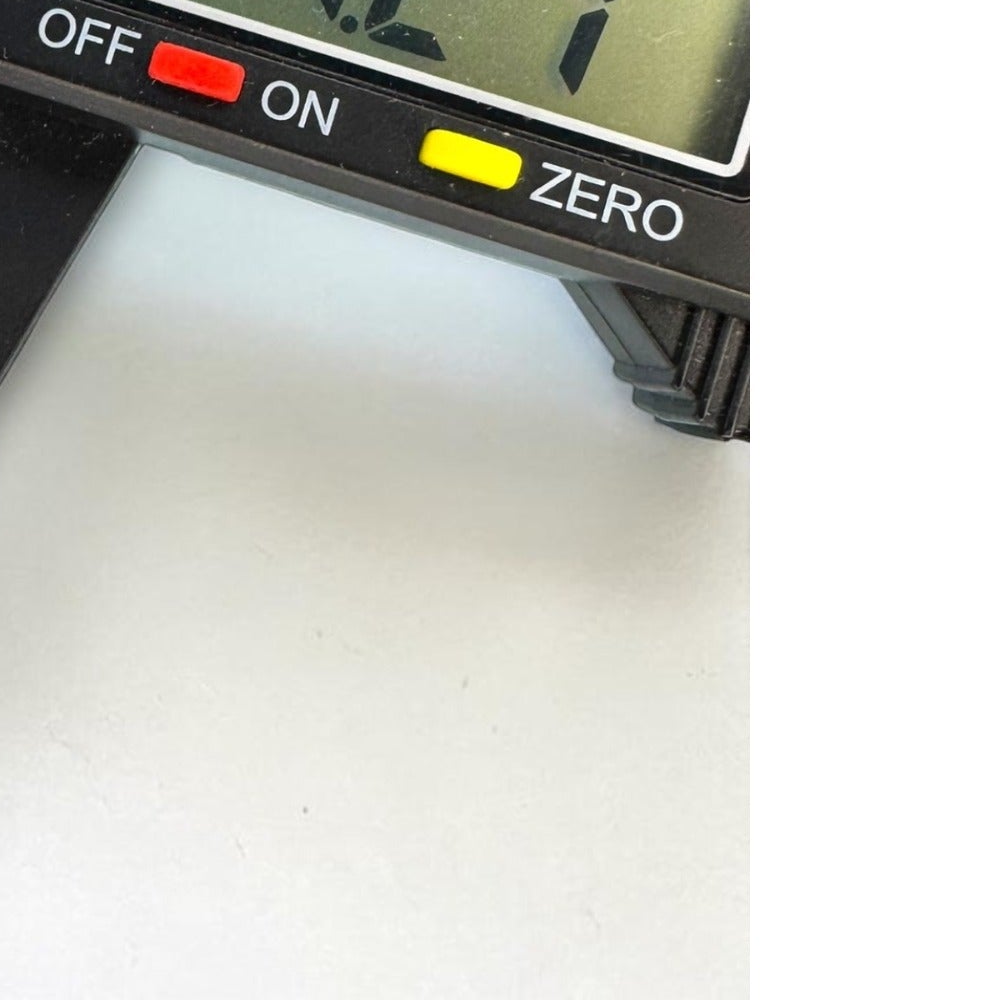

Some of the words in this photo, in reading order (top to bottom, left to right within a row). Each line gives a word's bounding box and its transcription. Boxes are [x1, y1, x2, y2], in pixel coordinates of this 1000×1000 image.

[37, 7, 143, 65] OFF
[261, 81, 340, 137] ON
[530, 163, 684, 242] ZERO
